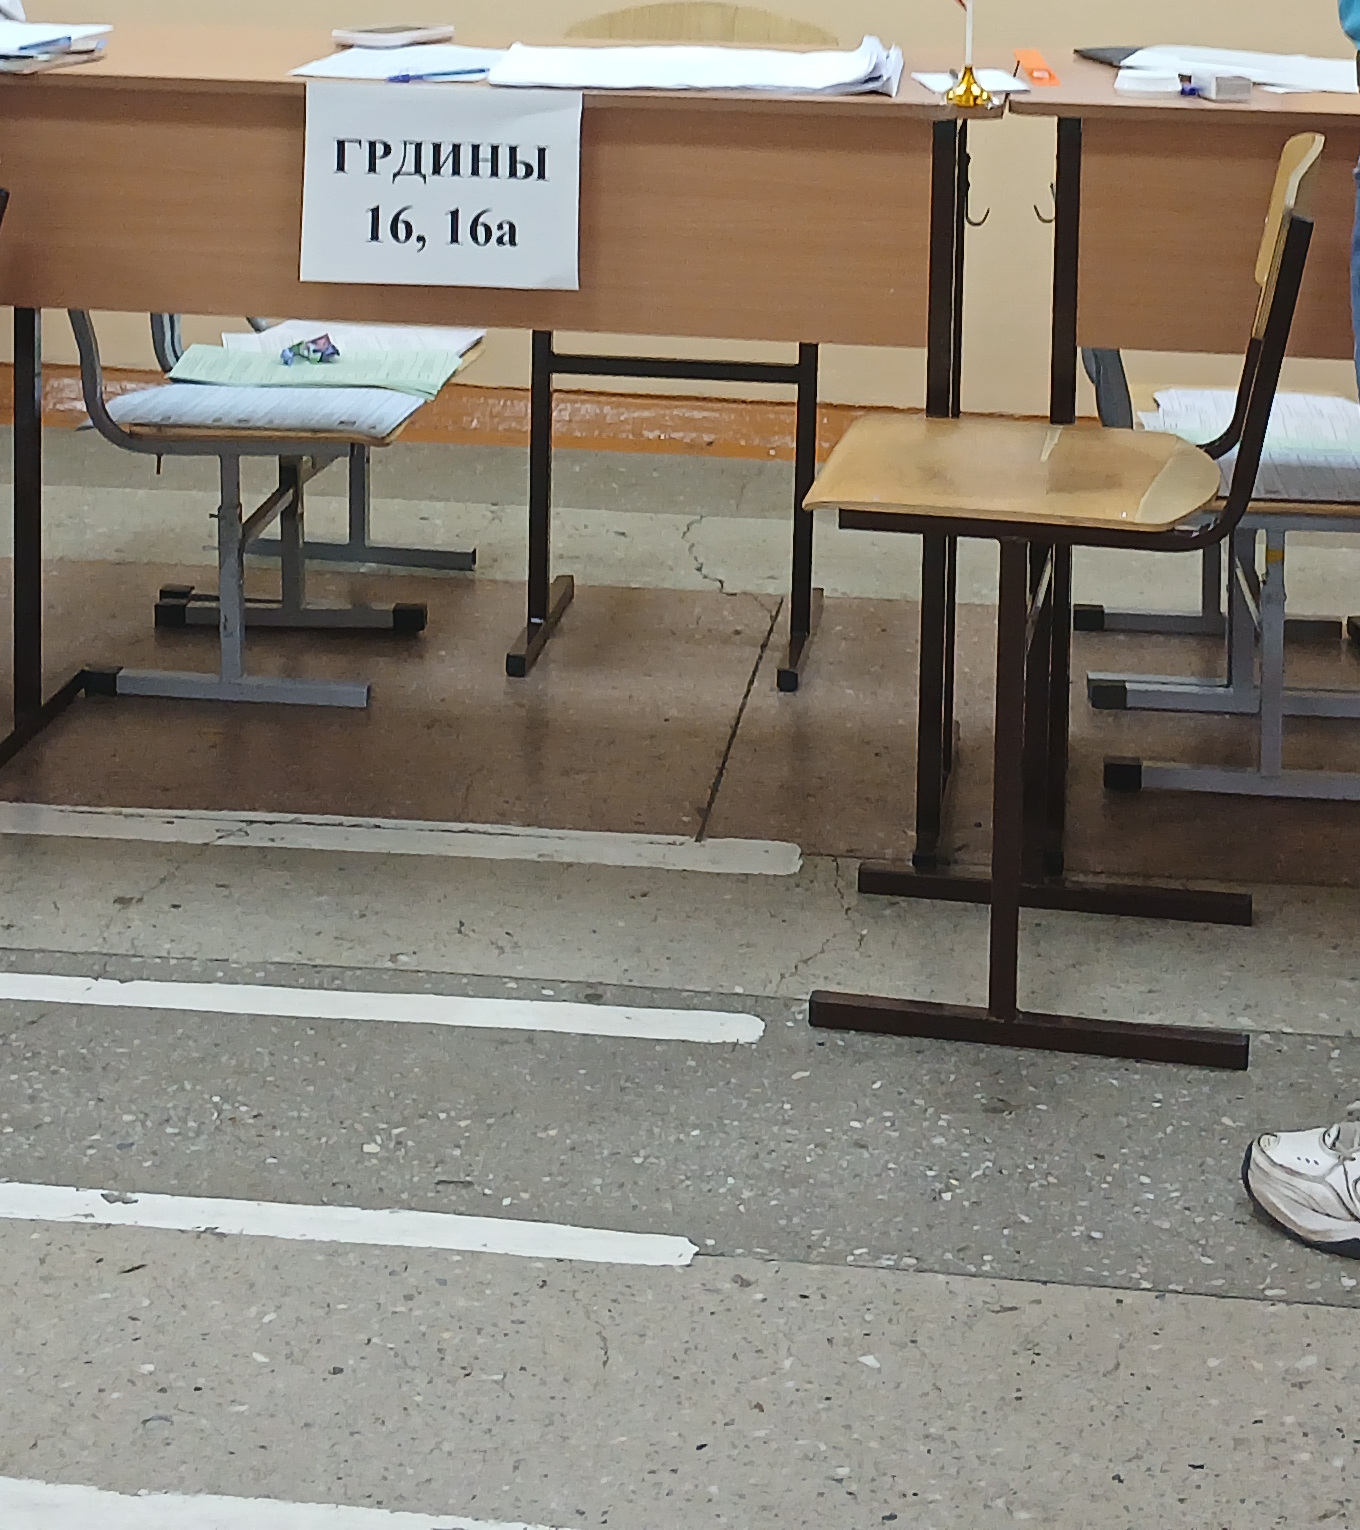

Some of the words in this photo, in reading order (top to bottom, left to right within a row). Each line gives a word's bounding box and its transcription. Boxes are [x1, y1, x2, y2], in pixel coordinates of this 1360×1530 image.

[332, 136, 551, 184] ГРДИНЫ
[365, 204, 427, 252] 16,
[445, 207, 518, 247] 16а
